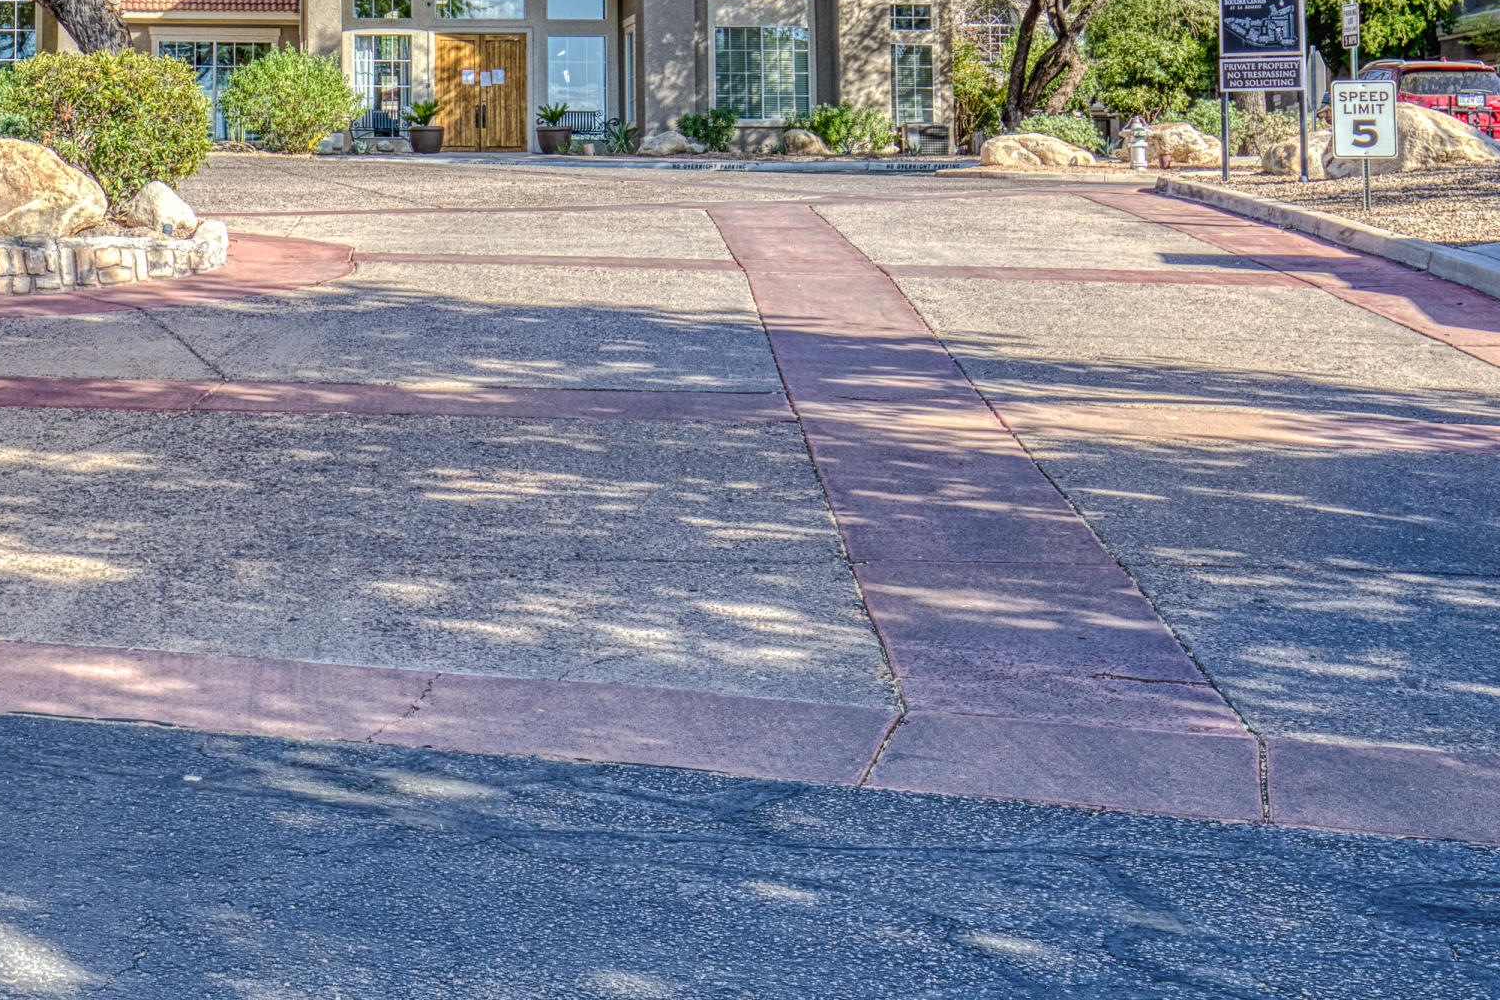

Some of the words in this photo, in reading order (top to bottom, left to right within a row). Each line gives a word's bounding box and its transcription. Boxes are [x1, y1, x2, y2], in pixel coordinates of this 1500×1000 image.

[1258, 62, 1299, 70] PROPERTY
[1227, 71, 1241, 79] NO
[1242, 70, 1296, 78] TRESPASSING
[1245, 78, 1294, 86] SOLICITING
[1338, 91, 1389, 102] SPEED
[1343, 103, 1385, 114] LIMIT
[1351, 119, 1379, 148] 5
